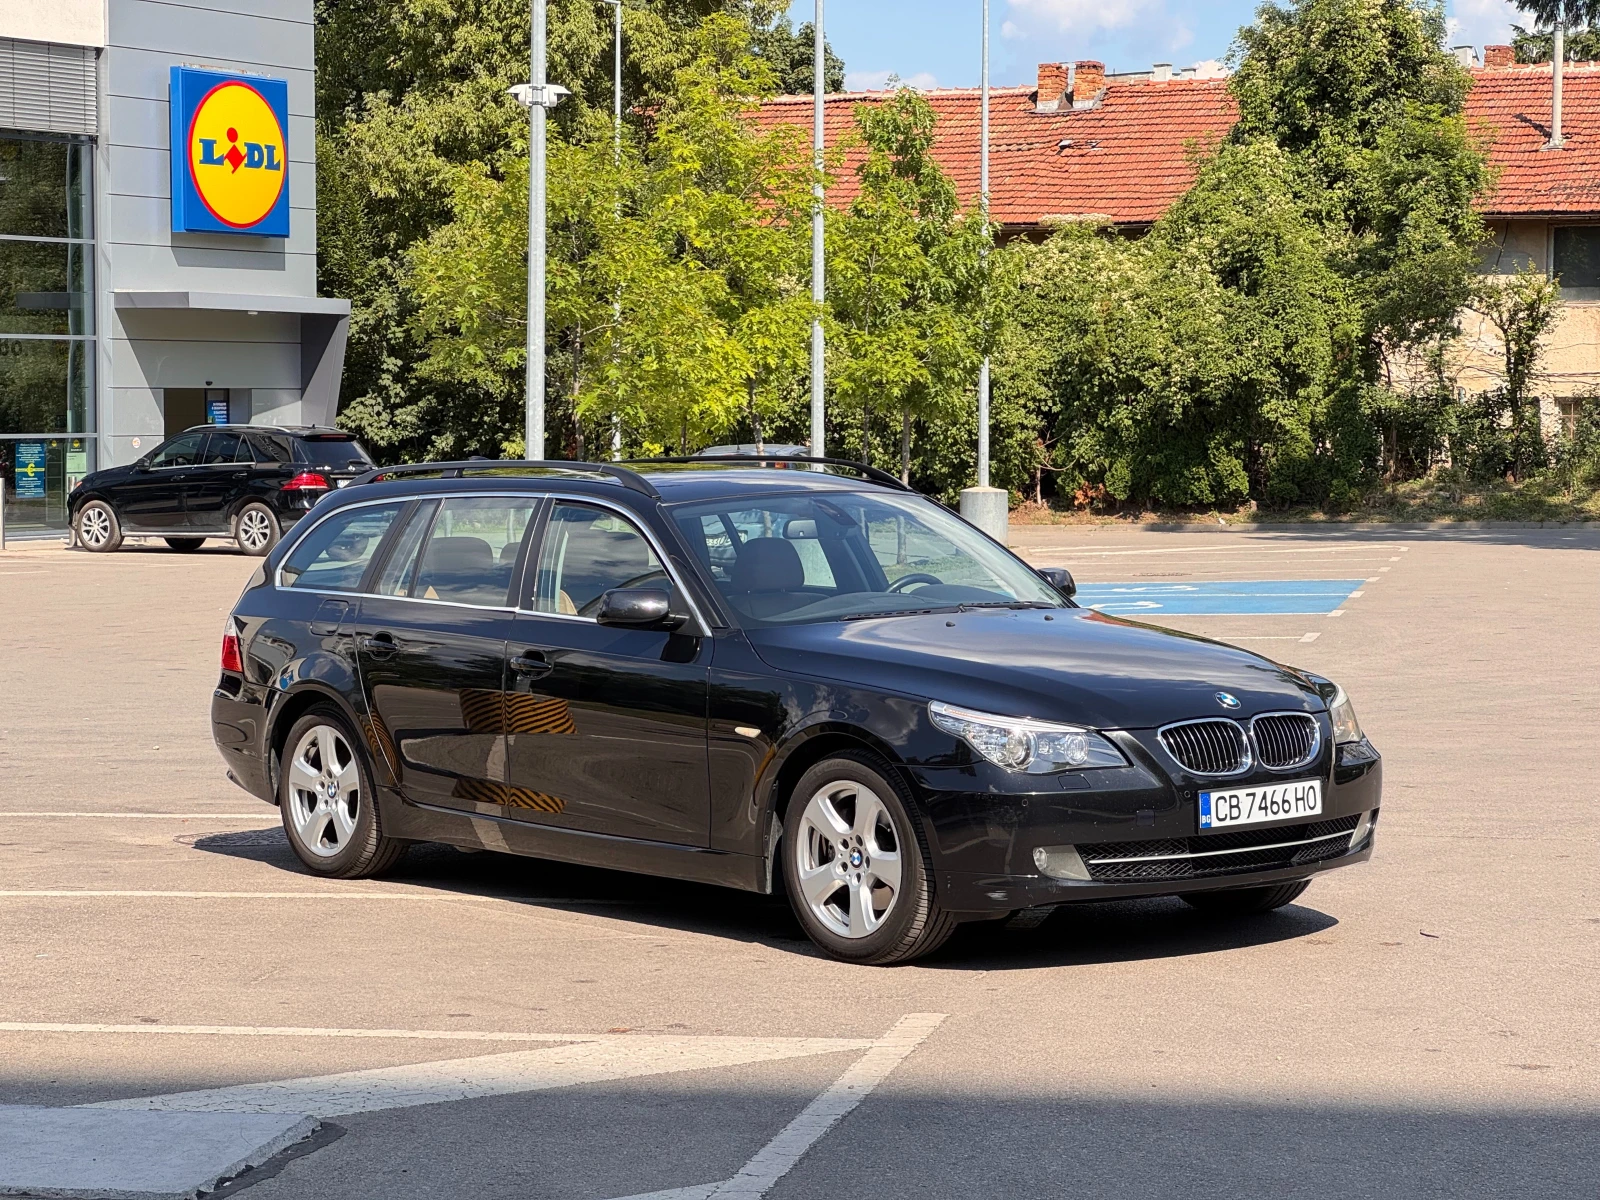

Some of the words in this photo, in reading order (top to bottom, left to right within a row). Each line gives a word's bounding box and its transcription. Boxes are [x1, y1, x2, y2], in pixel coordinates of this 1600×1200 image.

[1215, 794, 1241, 822] CB
[1246, 788, 1292, 819] 7466
[1201, 814, 1211, 824] BG
